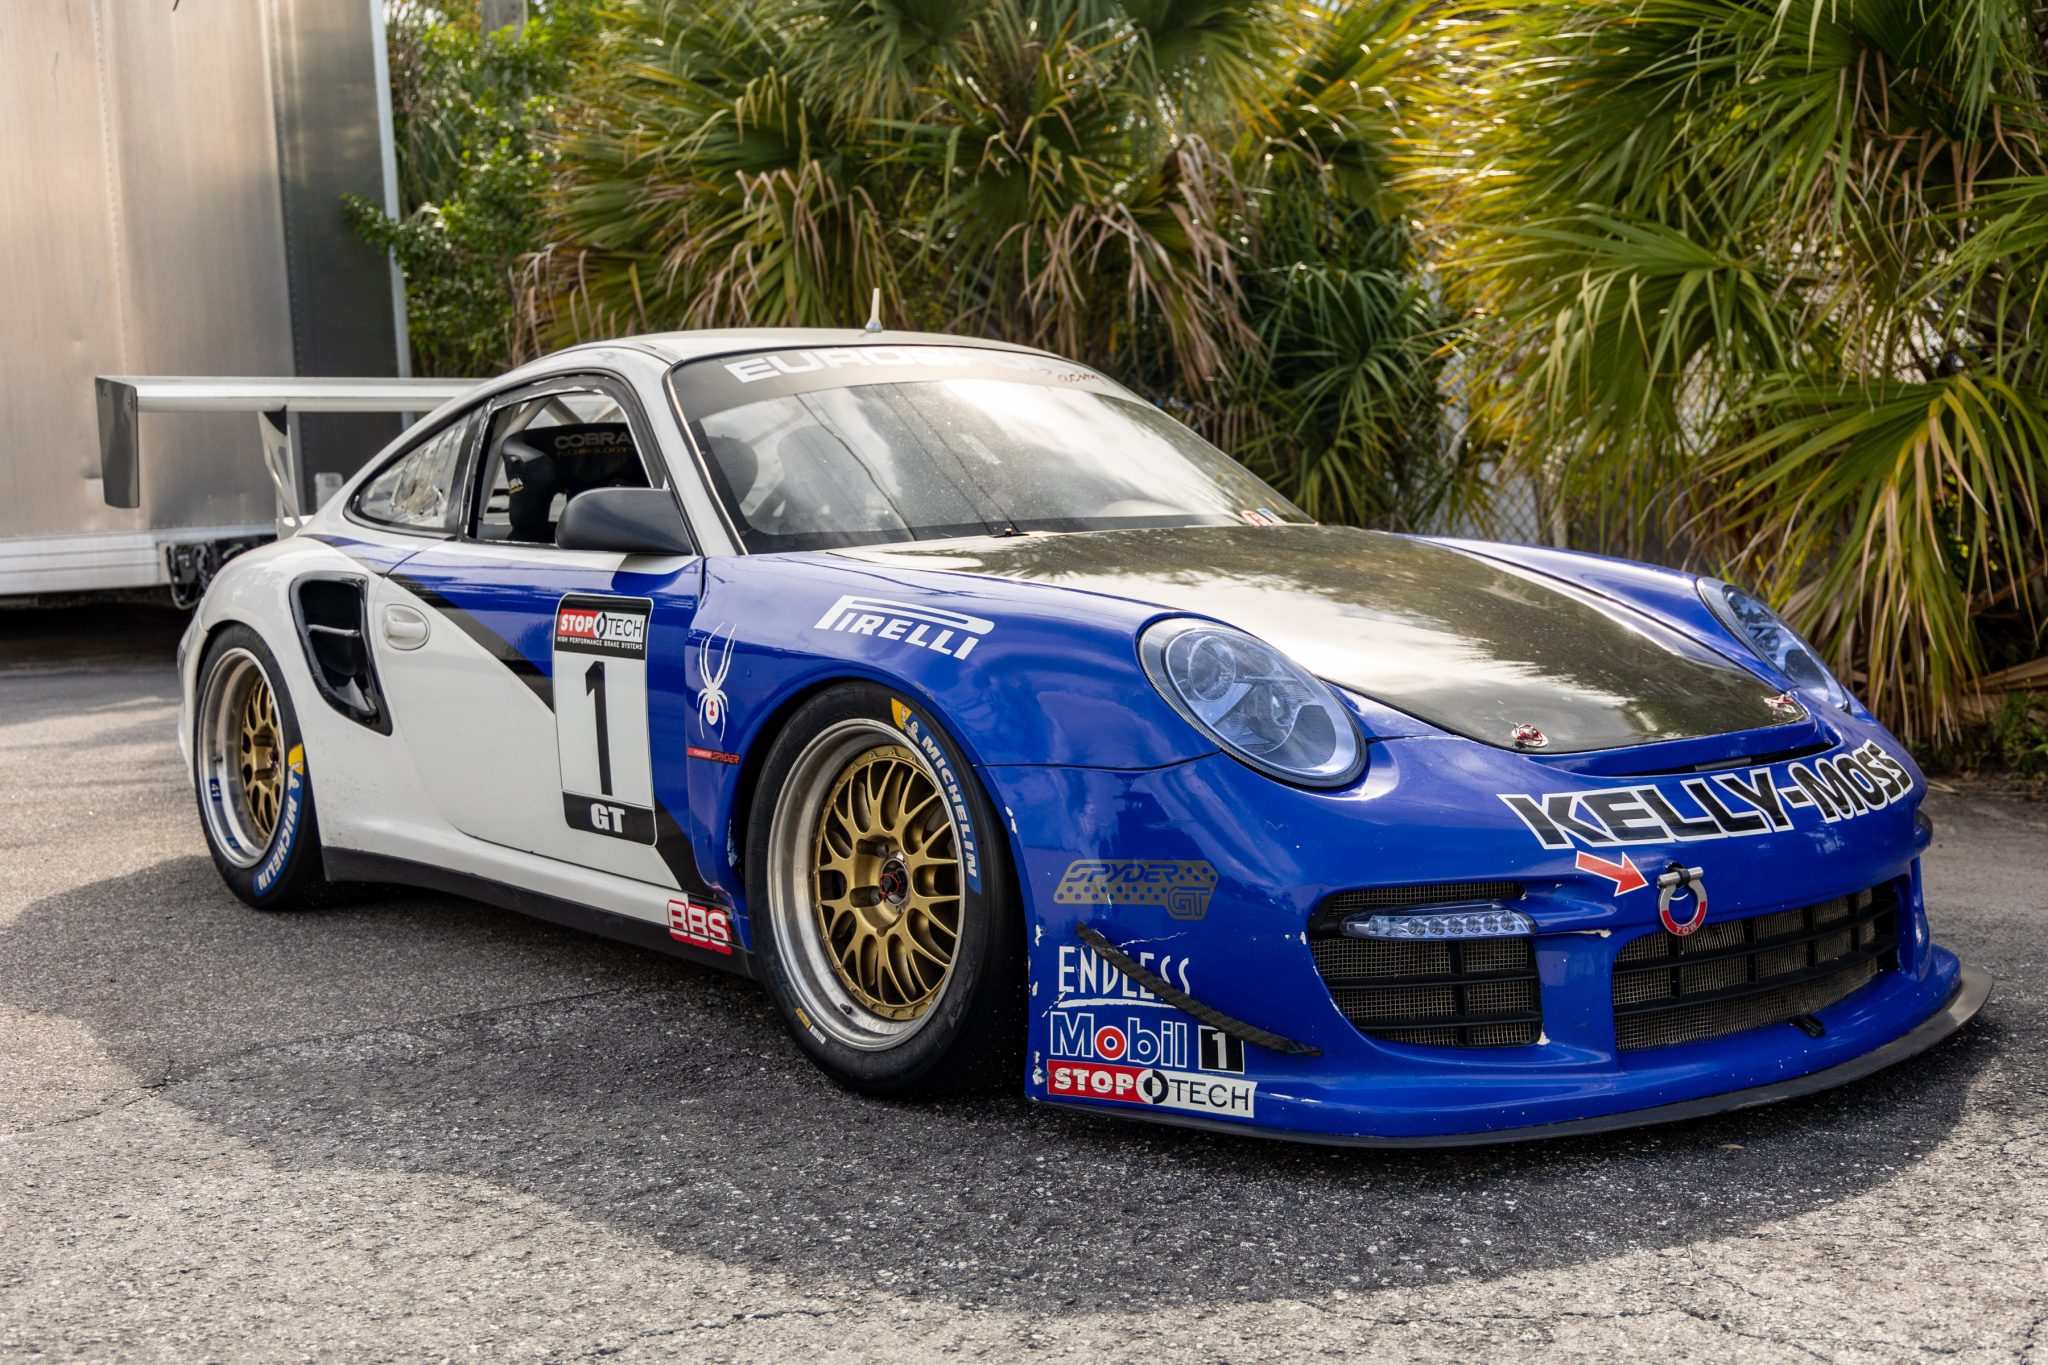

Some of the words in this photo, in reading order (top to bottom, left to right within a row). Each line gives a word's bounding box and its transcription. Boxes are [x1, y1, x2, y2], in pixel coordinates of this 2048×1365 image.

[554, 431, 632, 449] COBRA
[560, 614, 594, 633] STOP
[608, 618, 643, 637] TECH
[570, 638, 602, 646] PERFORMANCE
[621, 642, 643, 650] SYSTEMS
[813, 595, 995, 660] PIRELLI
[585, 661, 613, 796] 1
[711, 751, 740, 764] SPYDER
[922, 735, 978, 878] MICHELIN
[1496, 739, 1914, 850] KELLY-MOSS
[590, 803, 626, 833] GT
[258, 796, 297, 889] MICHELIN
[1065, 863, 1179, 884] SPYDER
[1167, 886, 1212, 917] GT
[667, 900, 729, 950] BBS
[1676, 921, 1697, 934] TOW
[1050, 1011, 1187, 1068] Mobil
[1211, 1032, 1228, 1069] 1
[1054, 1067, 1135, 1095] STOP
[1168, 1078, 1250, 1111] TECH
